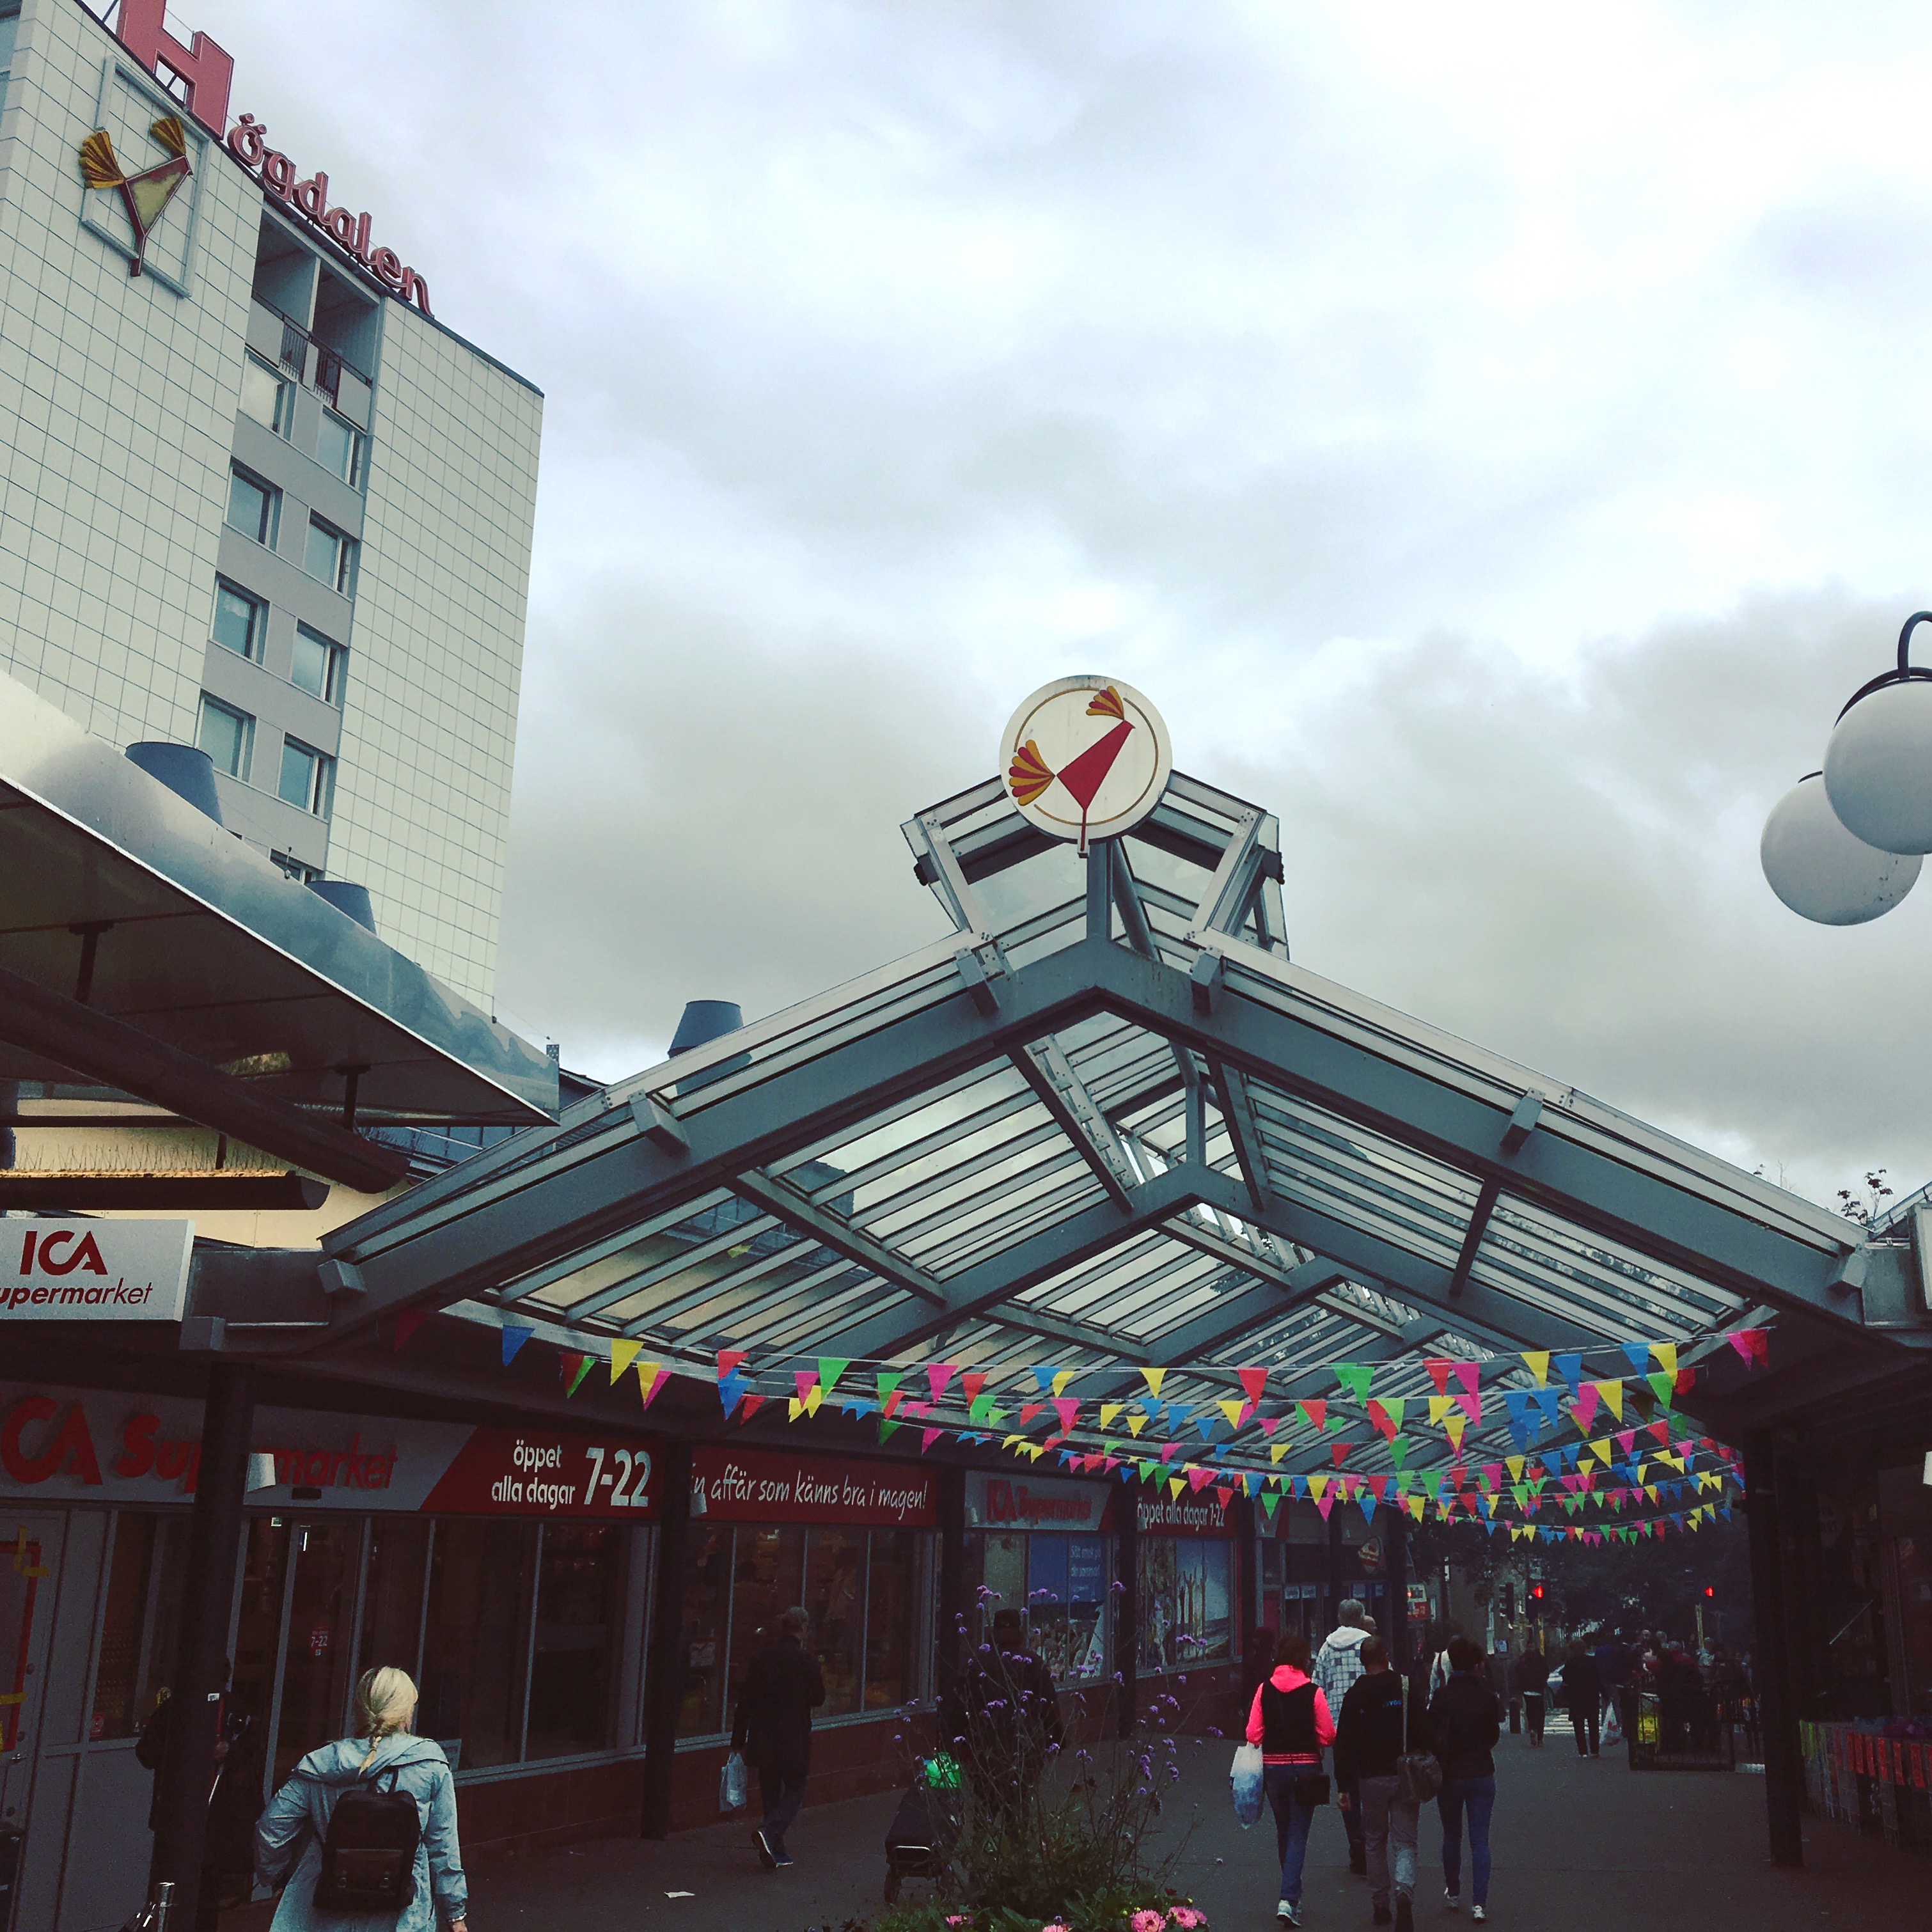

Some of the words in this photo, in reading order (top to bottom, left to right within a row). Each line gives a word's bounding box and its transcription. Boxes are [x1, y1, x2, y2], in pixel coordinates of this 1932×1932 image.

[116, 0, 436, 318] Högdalen
[20, 1230, 108, 1276] ICA
[0, 1277, 153, 1309] upermarket
[0, 1394, 103, 1486] CA
[514, 1439, 562, 1473] öppet
[491, 1475, 523, 1502] alla
[526, 1477, 576, 1510] dagar
[583, 1447, 652, 1507] 7-22
[711, 1463, 756, 1501] affär
[758, 1478, 790, 1502] som
[794, 1470, 839, 1505] känns
[842, 1474, 865, 1507] bra
[869, 1481, 876, 1507] i
[878, 1480, 929, 1521] magen!
[987, 1479, 1017, 1521] ICA
[1137, 1496, 1164, 1530] öppet
[1166, 1500, 1182, 1524] alla
[1183, 1500, 1208, 1532] dagar
[311, 1635, 328, 1647] 7-22
